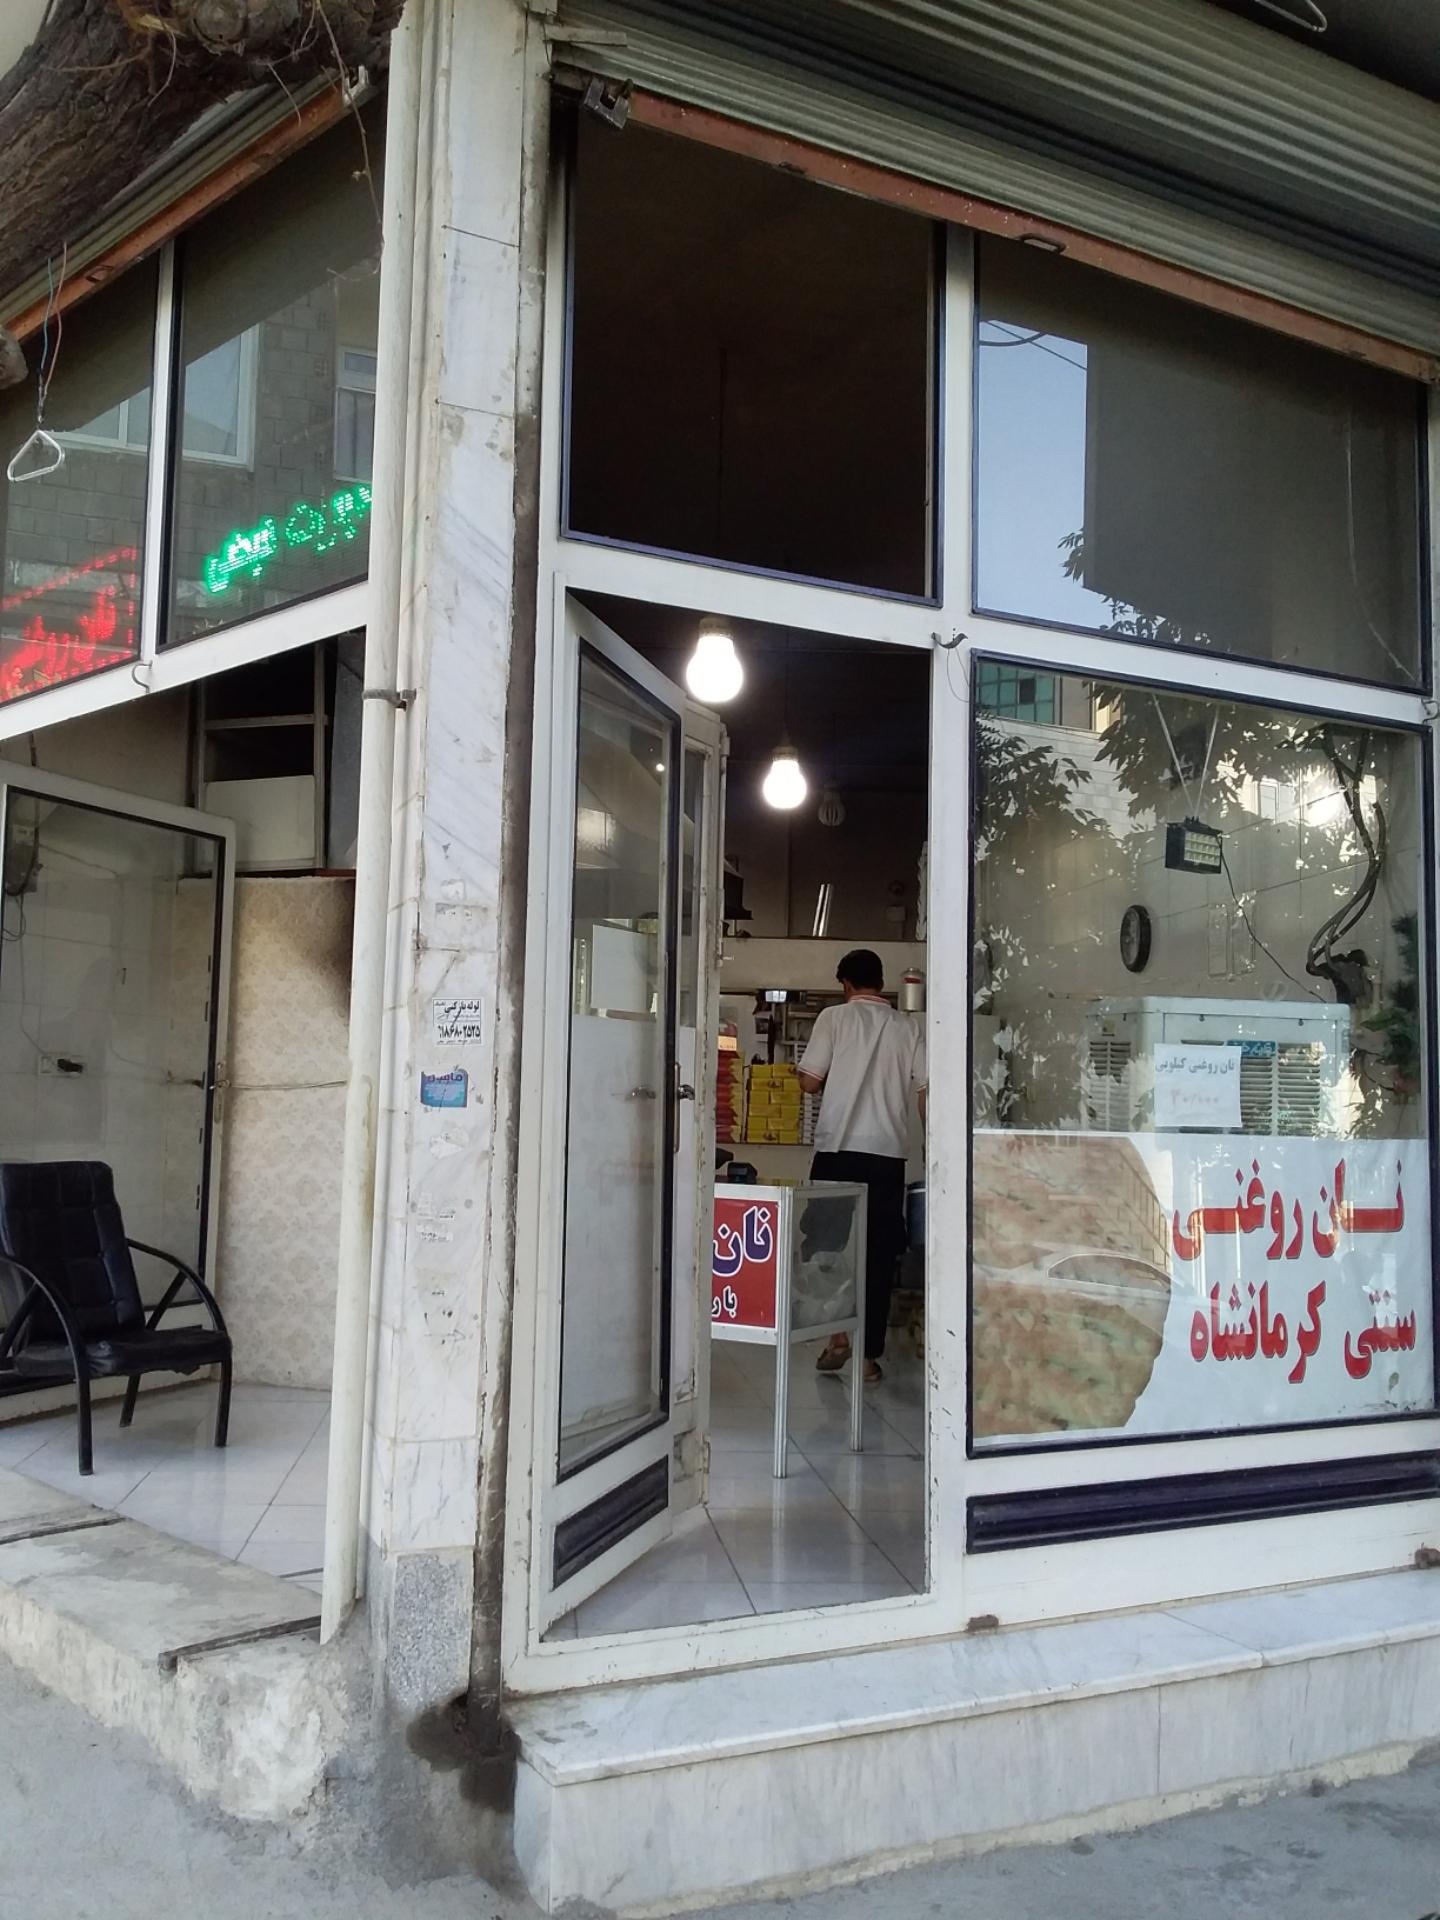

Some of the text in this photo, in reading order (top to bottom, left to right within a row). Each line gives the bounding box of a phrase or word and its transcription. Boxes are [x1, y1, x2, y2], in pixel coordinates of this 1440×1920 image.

[1220, 1057, 1235, 1074] نان
[1173, 1159, 1405, 1260] نان روغنی
[1190, 1280, 1416, 1383] سنتی کرمانشاه
